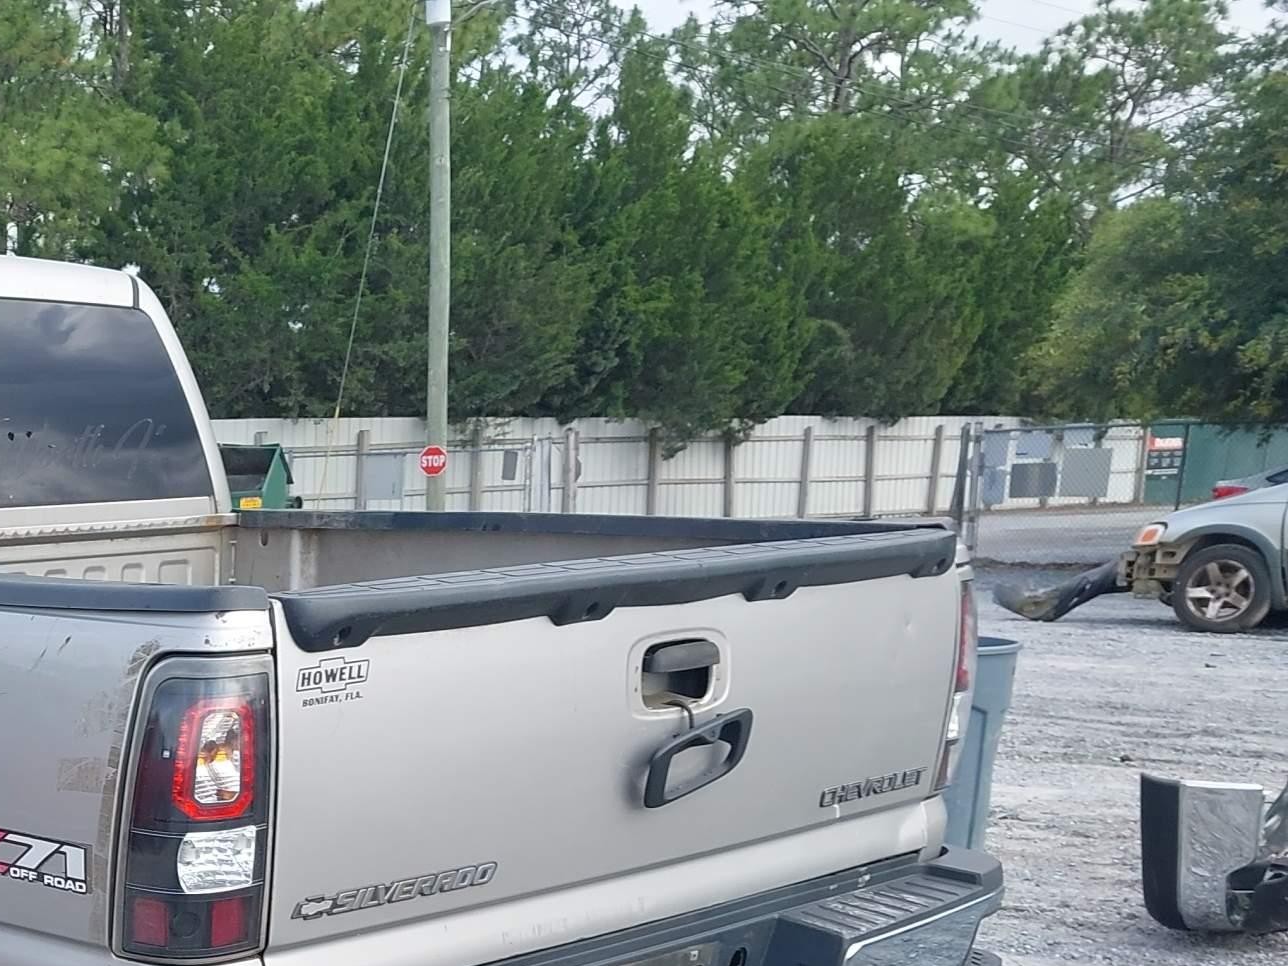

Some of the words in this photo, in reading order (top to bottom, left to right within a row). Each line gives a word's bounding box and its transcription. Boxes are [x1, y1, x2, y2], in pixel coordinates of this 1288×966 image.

[421, 455, 446, 467] STOP
[301, 664, 365, 687] HOWELL
[302, 694, 343, 707] BONIFAY,
[819, 766, 928, 808] CHEVROLET
[9, 867, 38, 882] OFF
[44, 875, 87, 893] ROAD
[327, 861, 498, 916] SILVERADO
